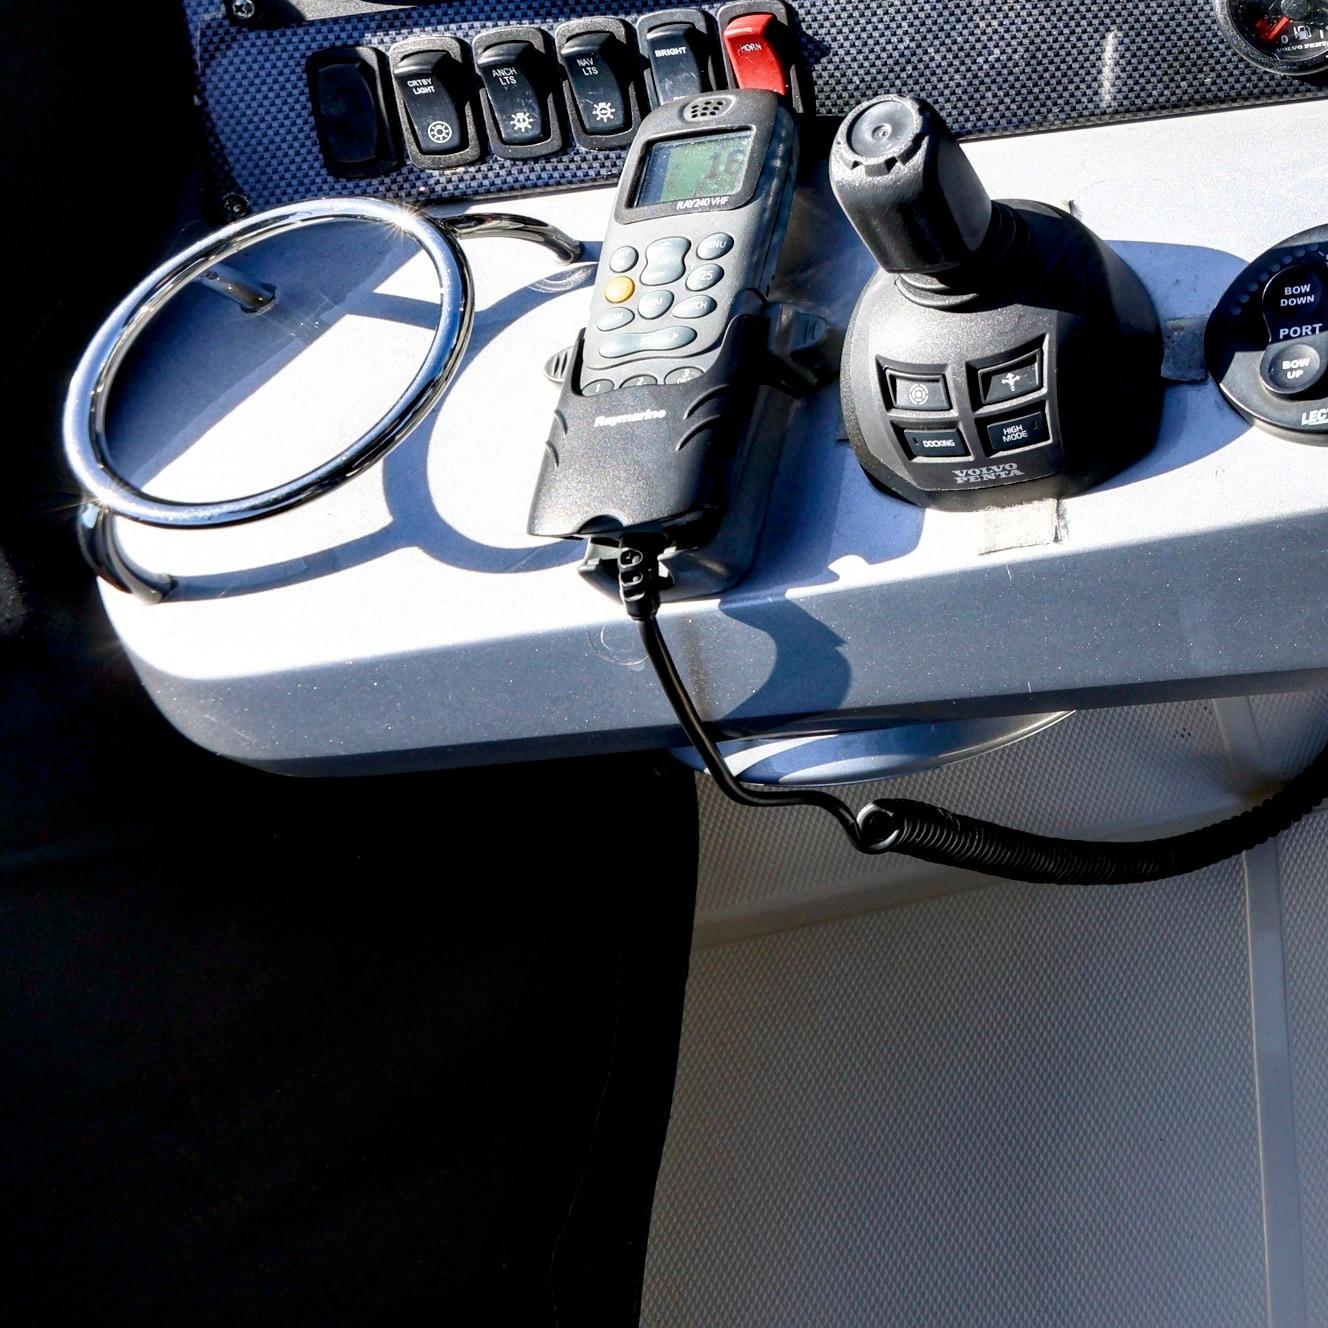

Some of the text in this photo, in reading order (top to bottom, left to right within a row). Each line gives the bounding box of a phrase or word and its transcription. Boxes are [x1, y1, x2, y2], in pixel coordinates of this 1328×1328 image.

[654, 46, 687, 58] BRIGHT
[740, 43, 762, 52] HORN
[577, 57, 595, 70] NAV
[492, 67, 518, 80] ANCH
[582, 64, 599, 76] LTS
[407, 78, 433, 91] CRTSY
[499, 73, 517, 85] LTS
[413, 84, 436, 95] LIGHT
[676, 196, 730, 210] RAY240 VHF
[1284, 284, 1311, 295] BOW
[1280, 295, 1315, 307] DOWN
[1279, 323, 1323, 340] PORT
[1282, 357, 1310, 370] BOW
[1287, 369, 1304, 379] UP
[1003, 424, 1024, 436] HIGH
[1003, 430, 1029, 442] MODE
[922, 437, 955, 449] DOCKING
[952, 462, 1018, 479] VOLVO
[954, 468, 1024, 484] PENTA
